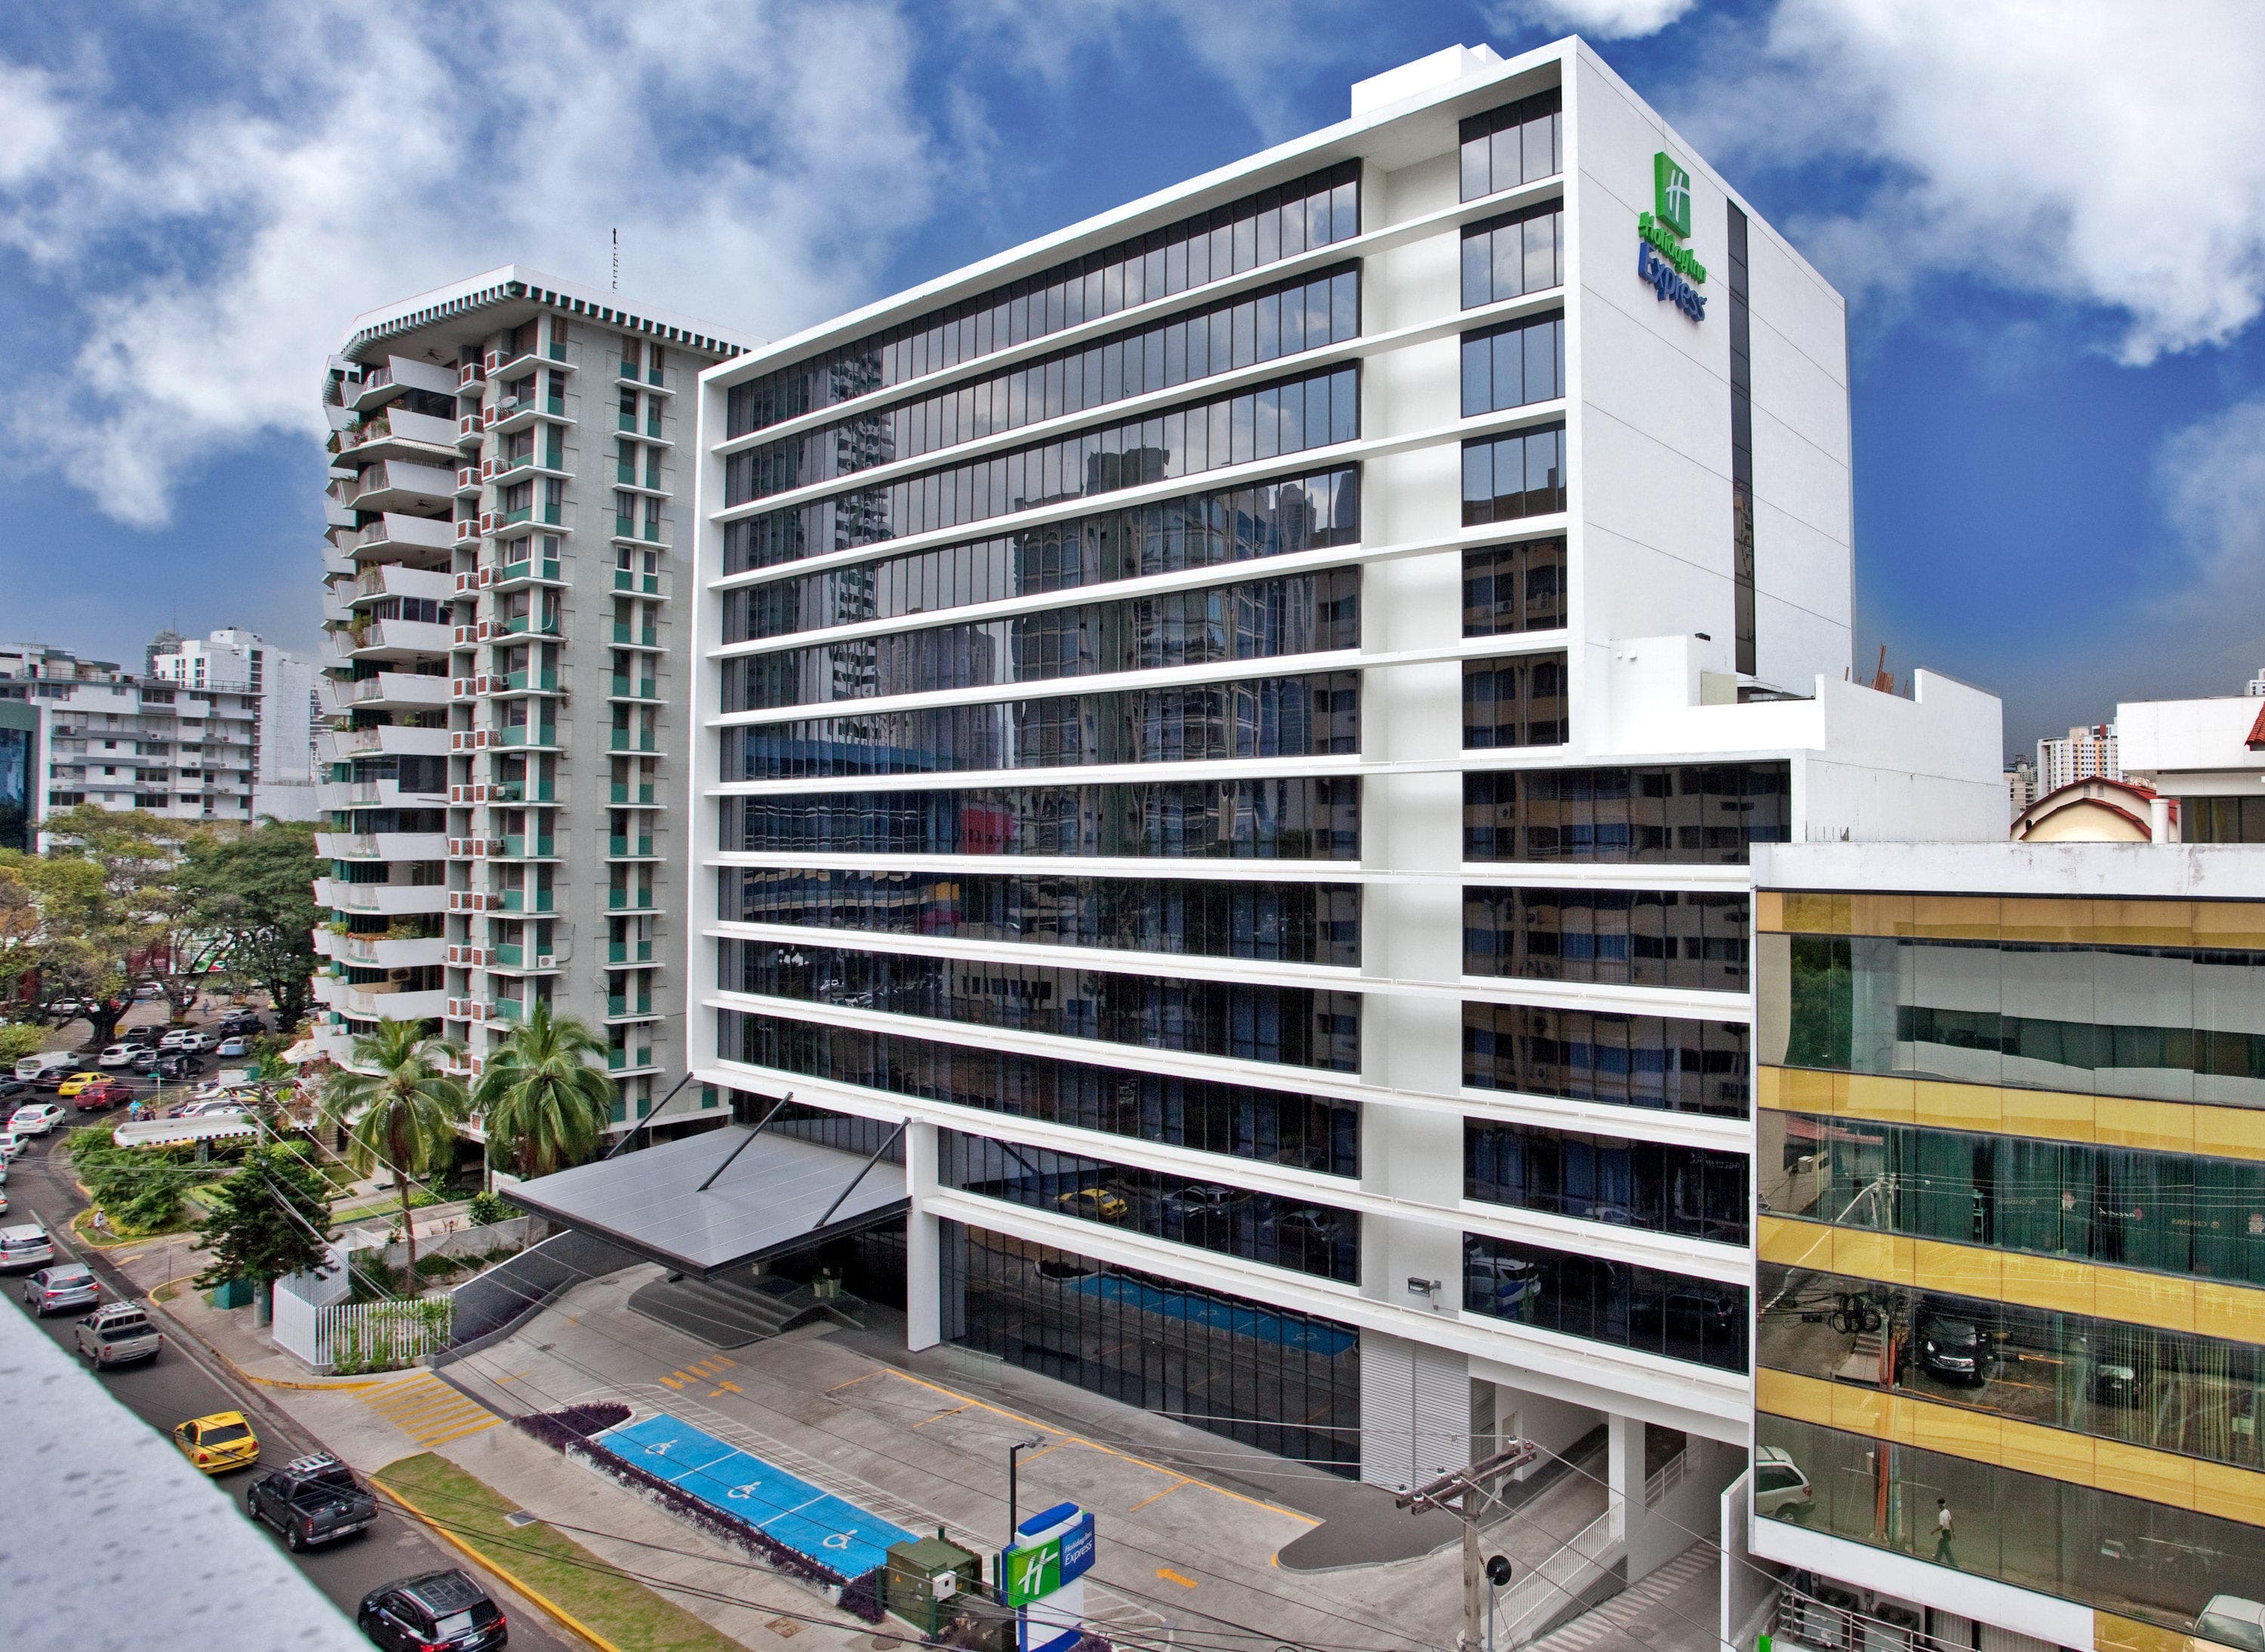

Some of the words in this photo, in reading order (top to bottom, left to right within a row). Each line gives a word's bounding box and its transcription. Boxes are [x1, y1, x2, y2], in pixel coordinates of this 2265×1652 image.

[1638, 211, 1690, 273] Holiday
[1638, 242, 1707, 322] Express
[1065, 1536, 1085, 1554] Holiday
[1065, 1540, 1092, 1566] Express
